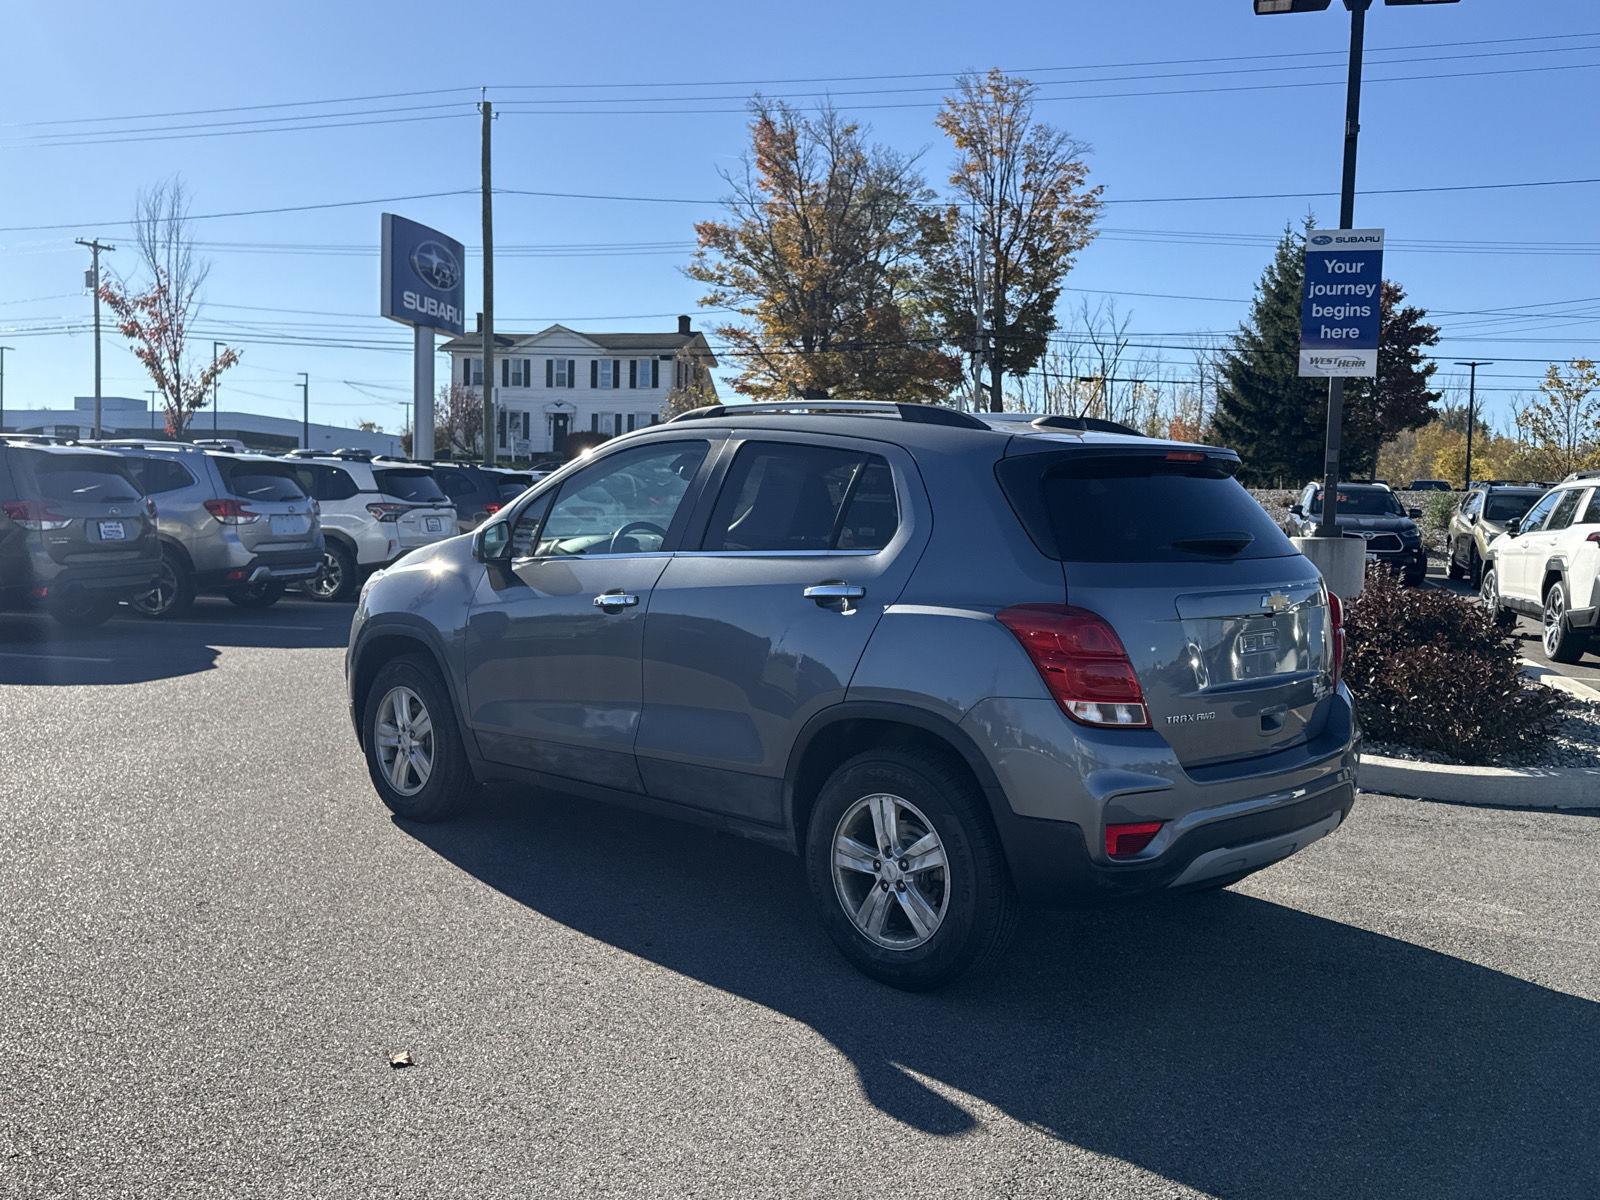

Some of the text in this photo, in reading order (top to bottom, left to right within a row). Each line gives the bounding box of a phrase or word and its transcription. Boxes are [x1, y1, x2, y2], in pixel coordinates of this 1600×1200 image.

[1335, 235, 1380, 243] SUBARU
[1324, 259, 1364, 274] Your
[1308, 281, 1376, 299] journey
[403, 290, 462, 326] SUBARU
[1311, 303, 1371, 320] begins
[1320, 324, 1360, 339] here
[1166, 711, 1216, 724] TRAX AWD
